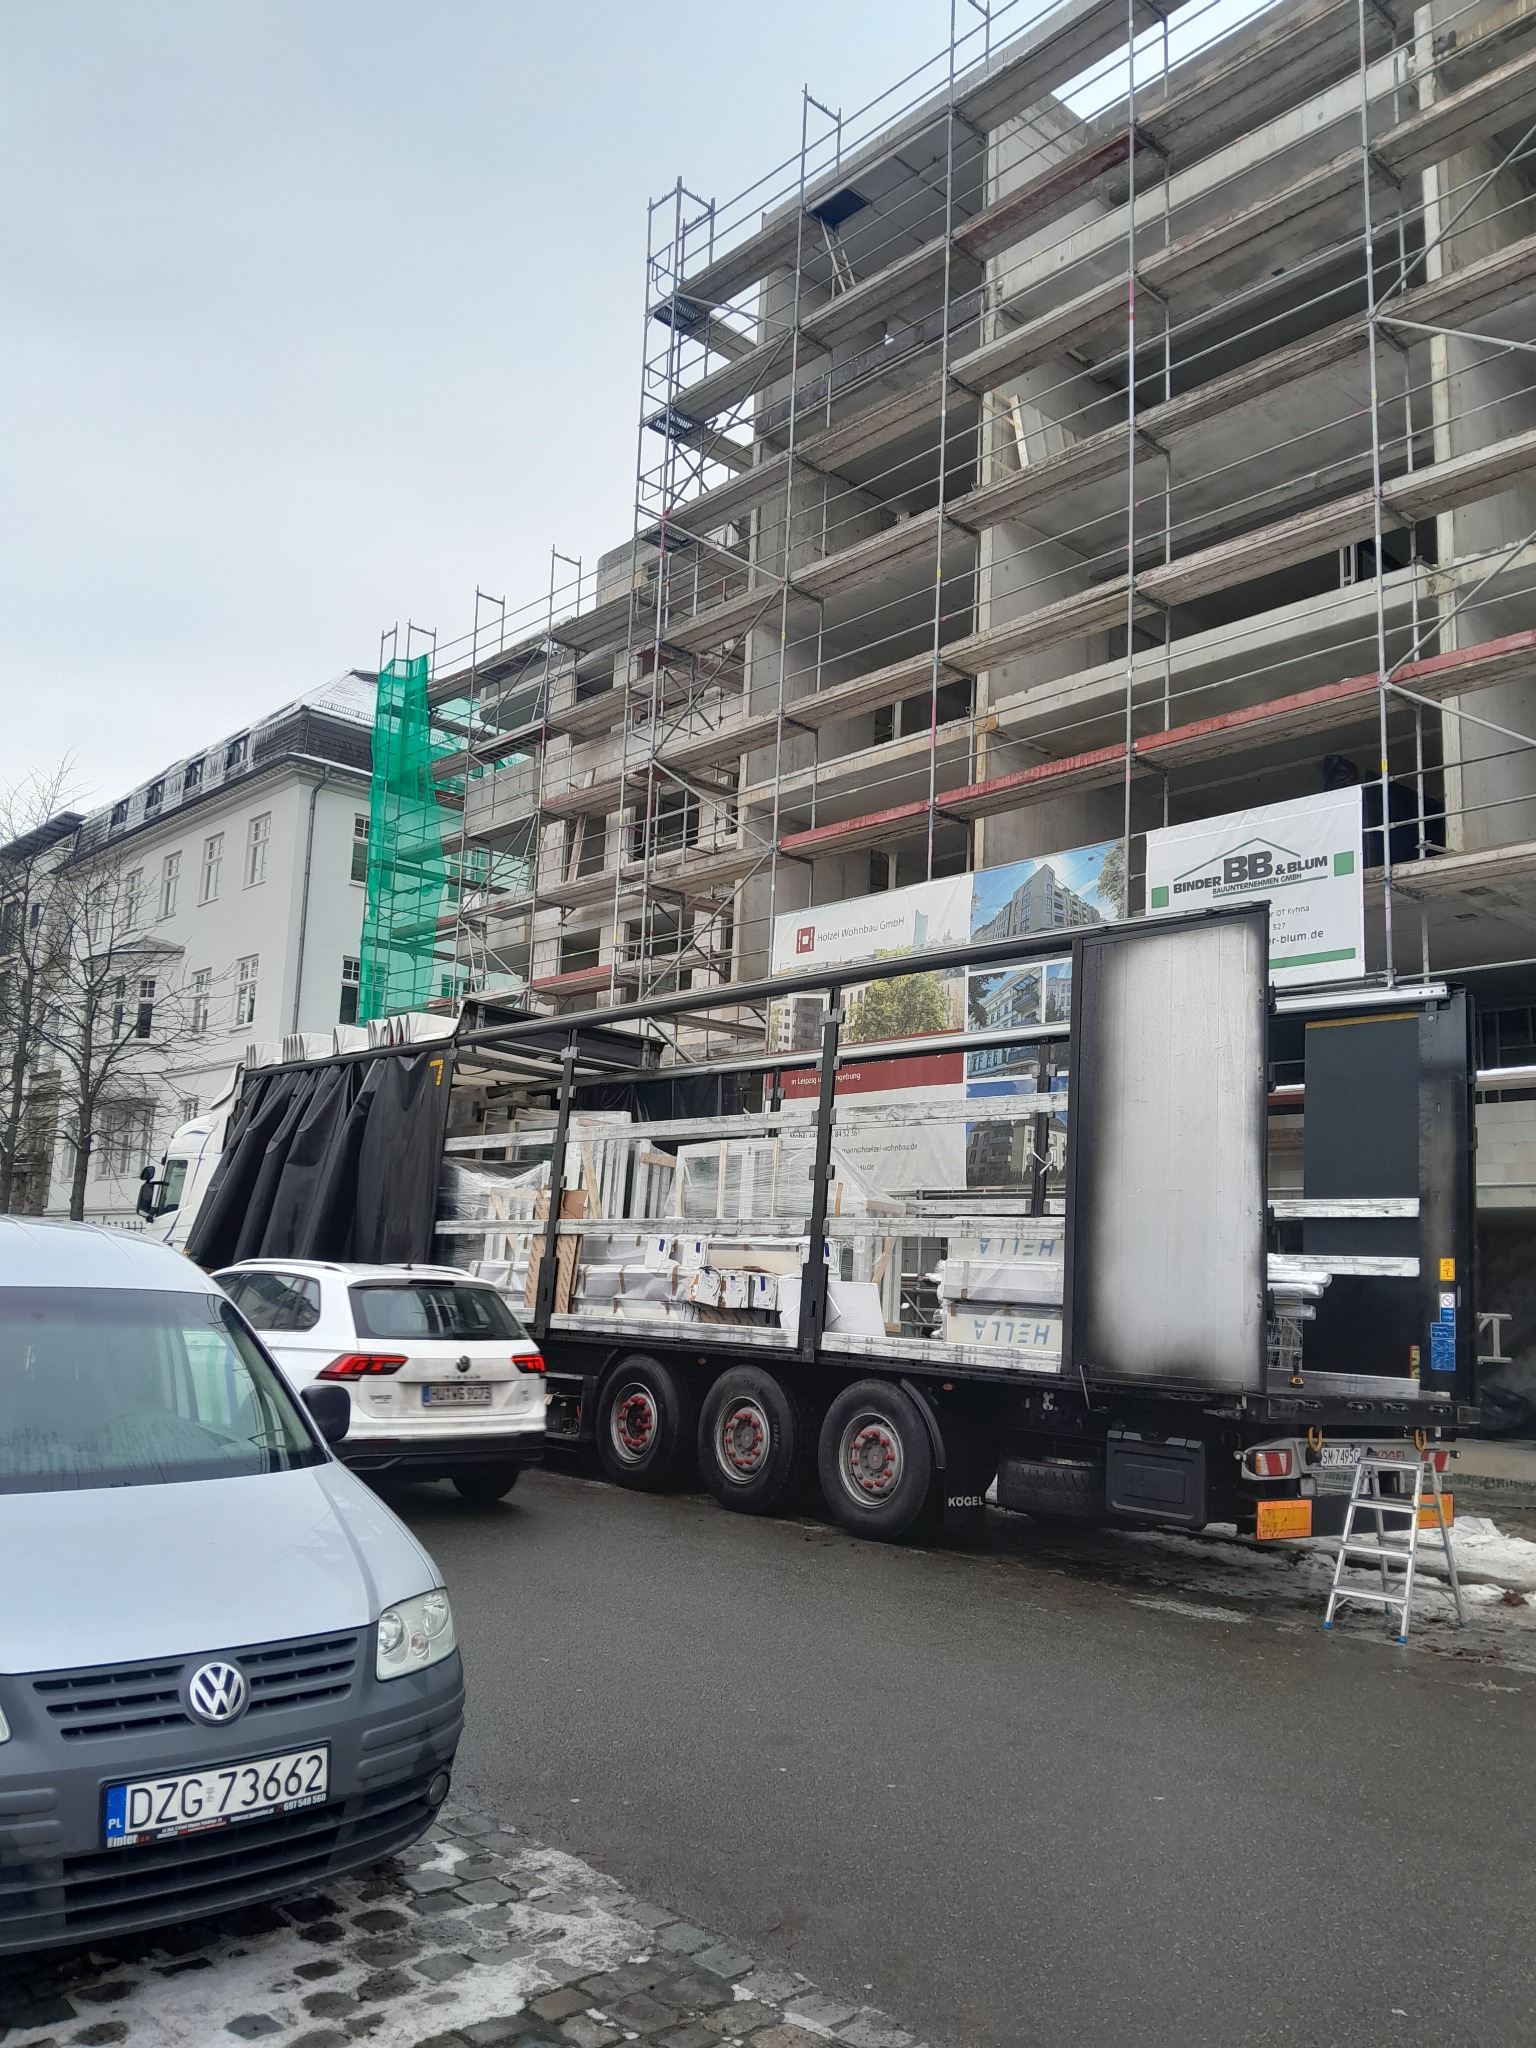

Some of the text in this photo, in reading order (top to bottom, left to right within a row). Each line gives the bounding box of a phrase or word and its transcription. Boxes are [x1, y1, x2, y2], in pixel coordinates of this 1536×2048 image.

[1173, 855, 1328, 894] BINDER & BLUM
[1223, 850, 1273, 885] BB
[1212, 872, 1302, 895] BAUUNTERNEHMEN GMBH
[1276, 908, 1286, 917] OT
[1287, 905, 1310, 915] Kyhna
[816, 916, 905, 943] Hölzel Wohnbau GmbH
[797, 1076, 817, 1086] Leipzig
[834, 1072, 861, 1083] mgebung
[973, 1319, 1050, 1346] HELLA
[128, 1753, 323, 1829] DZG 73662
[283, 1801, 298, 1812] 697
[108, 1818, 123, 1830] PL
